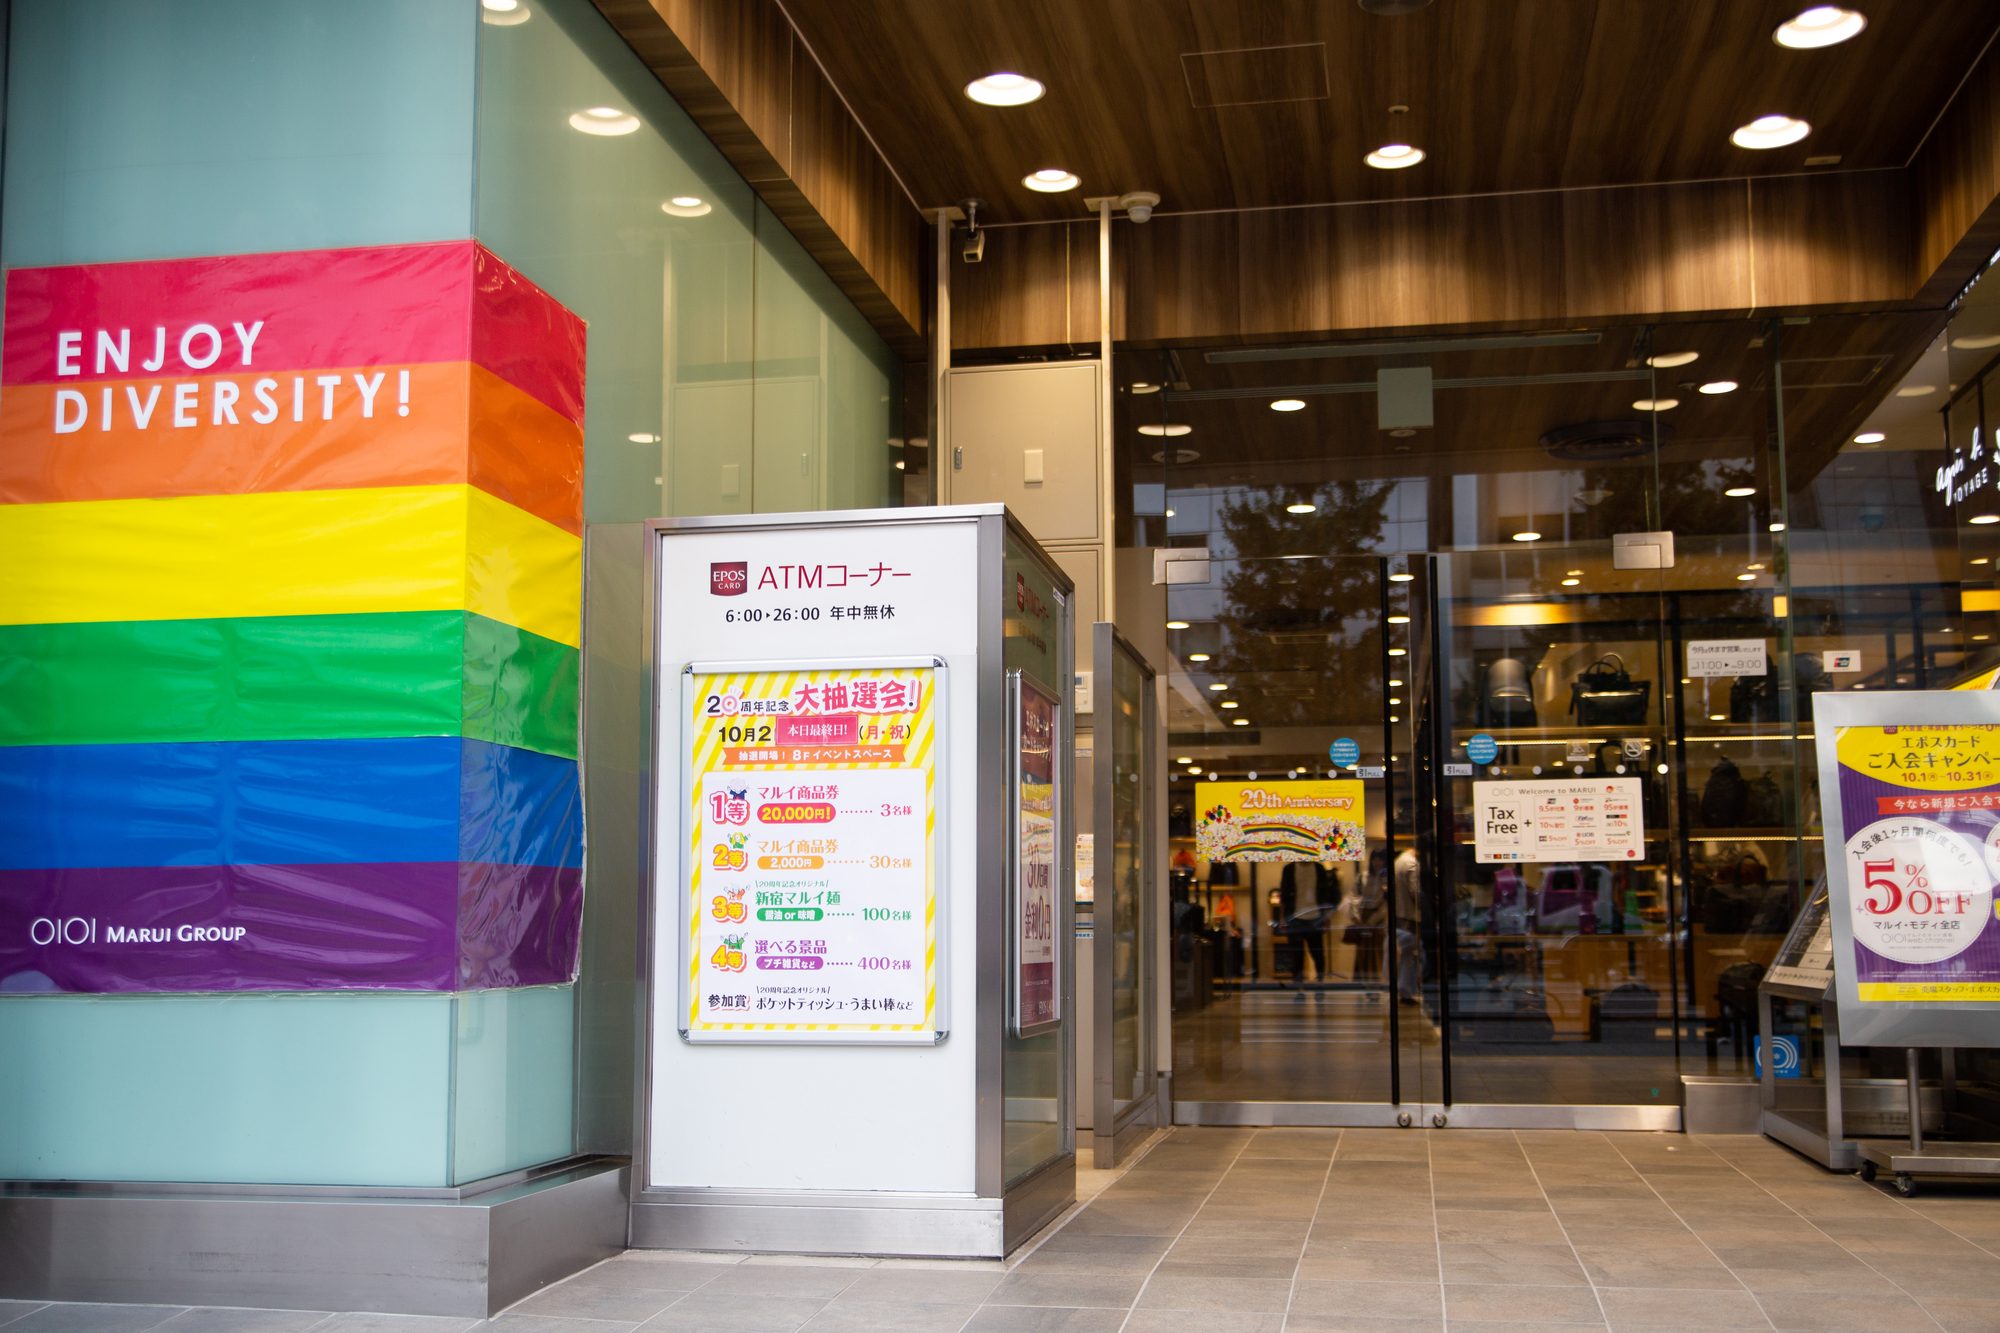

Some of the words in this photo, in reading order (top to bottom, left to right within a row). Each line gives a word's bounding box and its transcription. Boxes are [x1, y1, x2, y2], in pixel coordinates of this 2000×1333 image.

[57, 321, 264, 376] ENJOY
[55, 370, 411, 434] DIVERSITY!
[713, 570, 745, 582] EPOS
[758, 562, 911, 590] ATMコーナー
[718, 582, 741, 590] CARD
[726, 608, 762, 623] 6:00
[774, 607, 820, 622] 26:00
[830, 604, 895, 620] 年中無休
[787, 723, 847, 737] 本日最終日!
[1902, 735, 1980, 748] エポスカード
[757, 785, 839, 800] マルイ商品券
[1240, 788, 1282, 809] 20th
[1283, 795, 1353, 810] Anniversary
[711, 792, 747, 822] 1等
[880, 803, 912, 817] 3名様
[1488, 807, 1515, 820] Tax
[1487, 821, 1518, 834] Free
[757, 839, 839, 854] マルイ商品券
[713, 844, 745, 866] 2等
[770, 857, 812, 868] 2,000円
[869, 855, 912, 869] 30名様
[756, 891, 840, 906] 新宿マルイ麺
[1907, 890, 1974, 915] OFF
[712, 896, 743, 919] 3等
[784, 912, 796, 920] or
[862, 907, 912, 921] 100名様
[755, 940, 827, 955] 選べる景品
[711, 945, 743, 968] 4等
[858, 956, 912, 970] 400名様
[708, 994, 747, 1008] 参加賞
